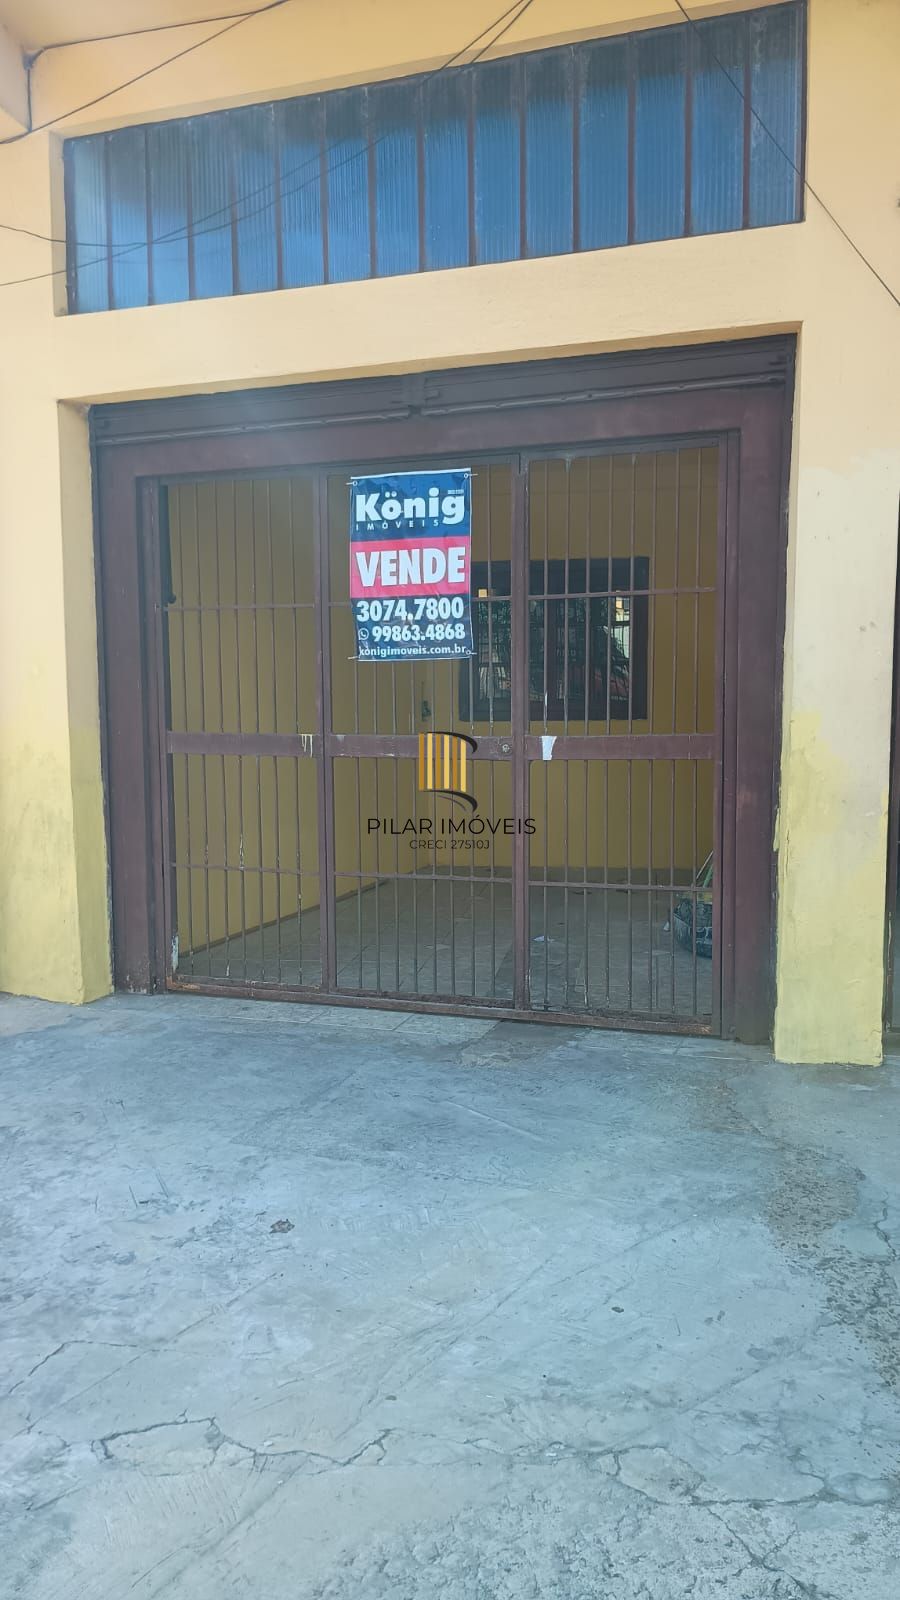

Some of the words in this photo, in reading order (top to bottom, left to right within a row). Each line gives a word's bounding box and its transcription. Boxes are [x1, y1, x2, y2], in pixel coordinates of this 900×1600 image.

[356, 487, 465, 524] König
[356, 519, 440, 531] IMÓVEIS
[356, 546, 466, 587] VENDE
[356, 597, 464, 622] 3074.7800
[372, 623, 466, 642] 99863.4868
